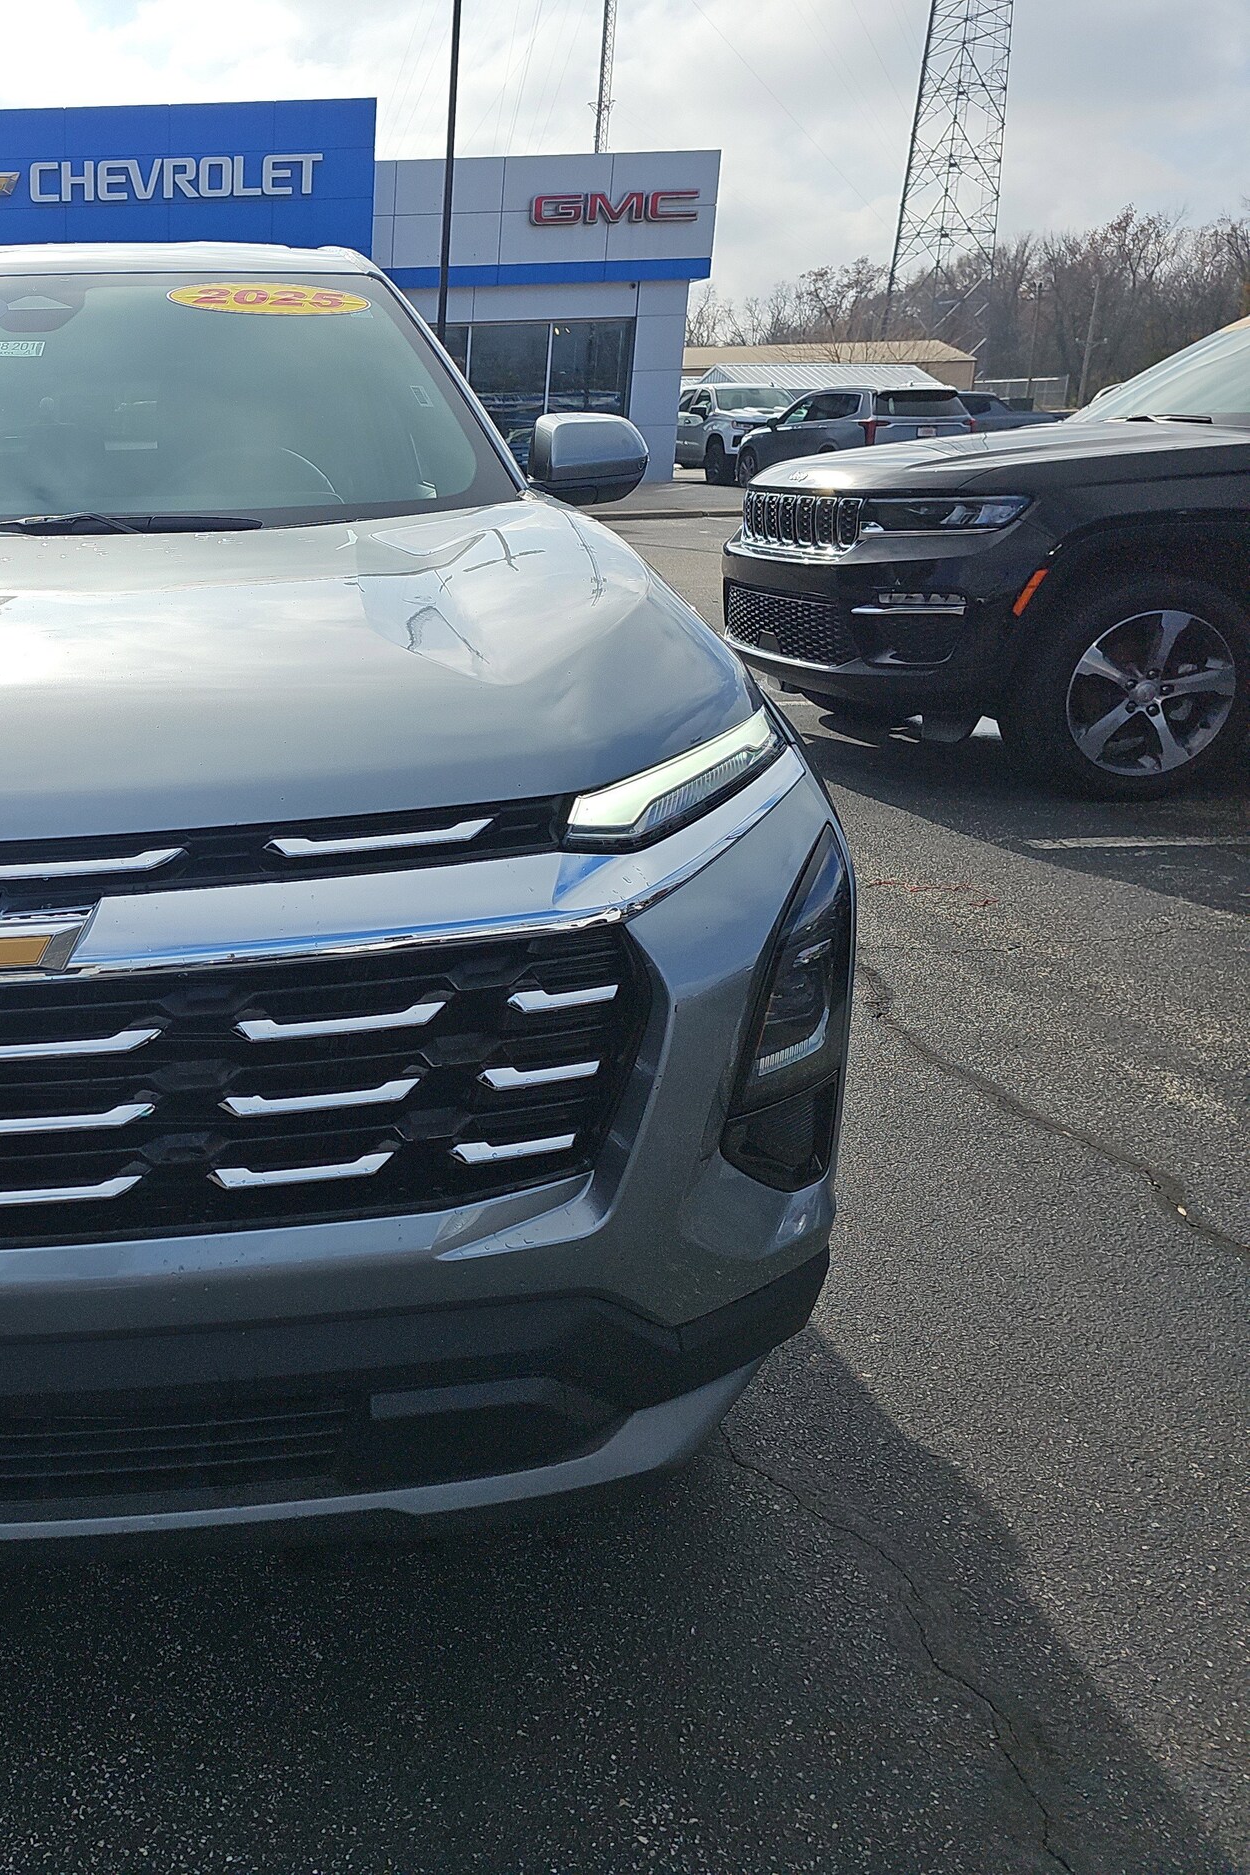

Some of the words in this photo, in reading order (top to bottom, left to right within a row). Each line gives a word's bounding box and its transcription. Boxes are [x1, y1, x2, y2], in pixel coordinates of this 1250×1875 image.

[28, 153, 324, 203] CHEVROLET
[531, 189, 700, 225] GMC
[193, 288, 346, 308] 2025
